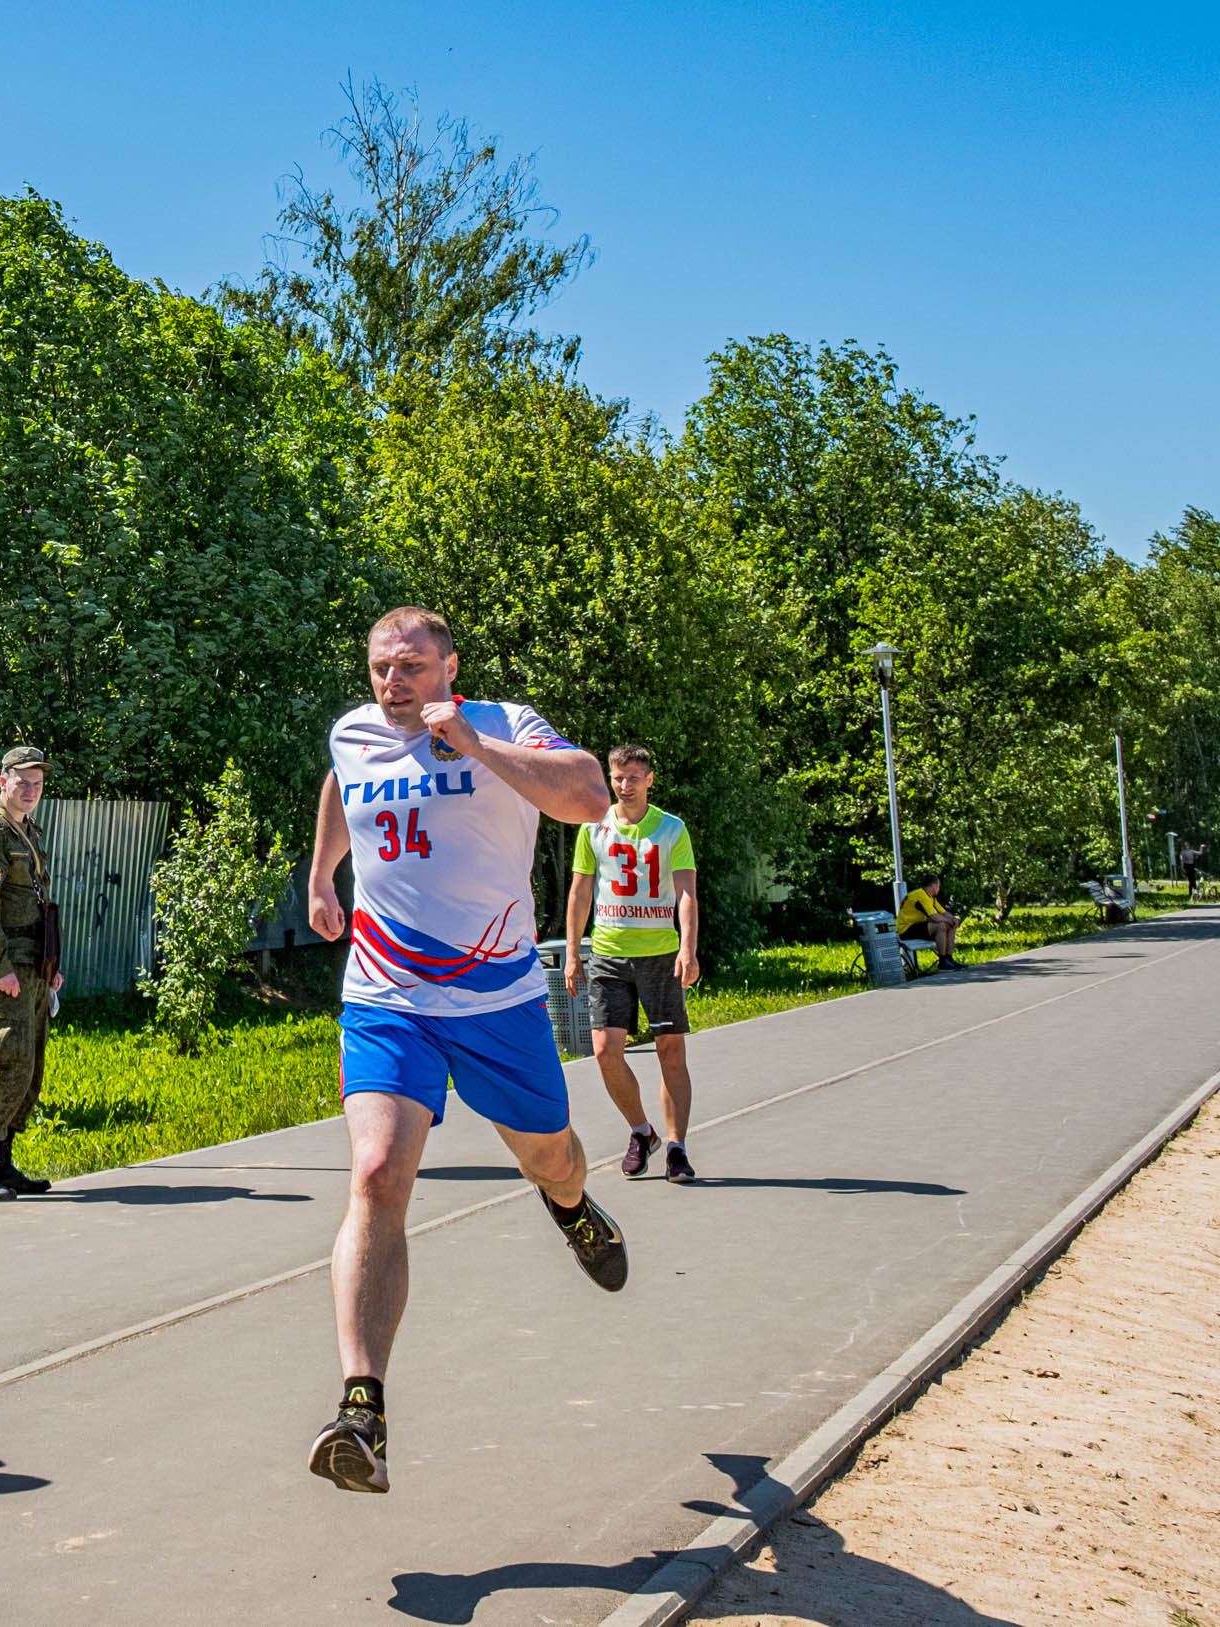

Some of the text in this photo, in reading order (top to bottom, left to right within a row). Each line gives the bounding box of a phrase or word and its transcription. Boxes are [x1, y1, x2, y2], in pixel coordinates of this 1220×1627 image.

[343, 770, 476, 806] ГИКЦ
[375, 807, 432, 862] 34
[608, 842, 660, 898] 31
[596, 904, 674, 919] РАСНОЗНАМЕНС
